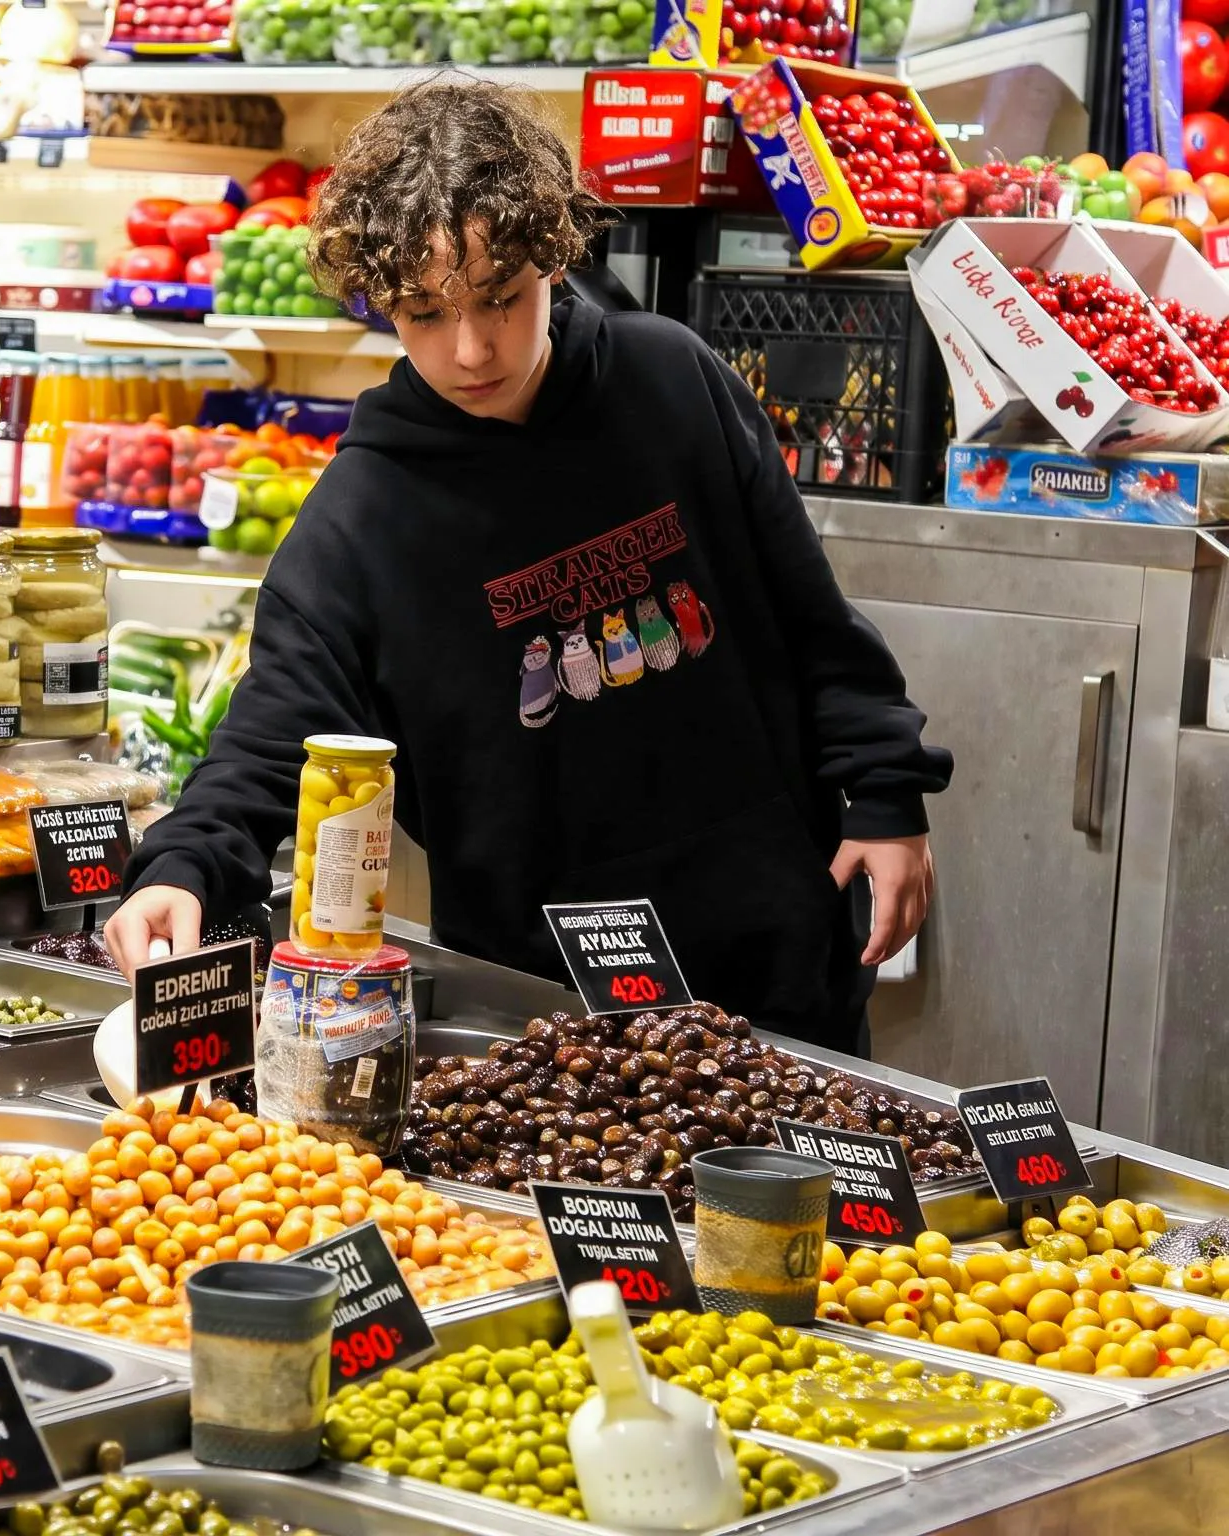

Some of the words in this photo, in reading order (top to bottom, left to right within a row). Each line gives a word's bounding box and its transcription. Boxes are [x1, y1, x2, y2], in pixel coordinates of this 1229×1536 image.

[487, 510, 687, 620] STRANGER
[550, 561, 651, 624] CATS
[68, 864, 112, 894] 320
[154, 961, 233, 1004] EDREMİT
[610, 975, 658, 1003] 420
[173, 1032, 221, 1075] 390
[1017, 1153, 1059, 1186] 460
[841, 1202, 894, 1236] 450
[331, 1322, 396, 1377] 390
